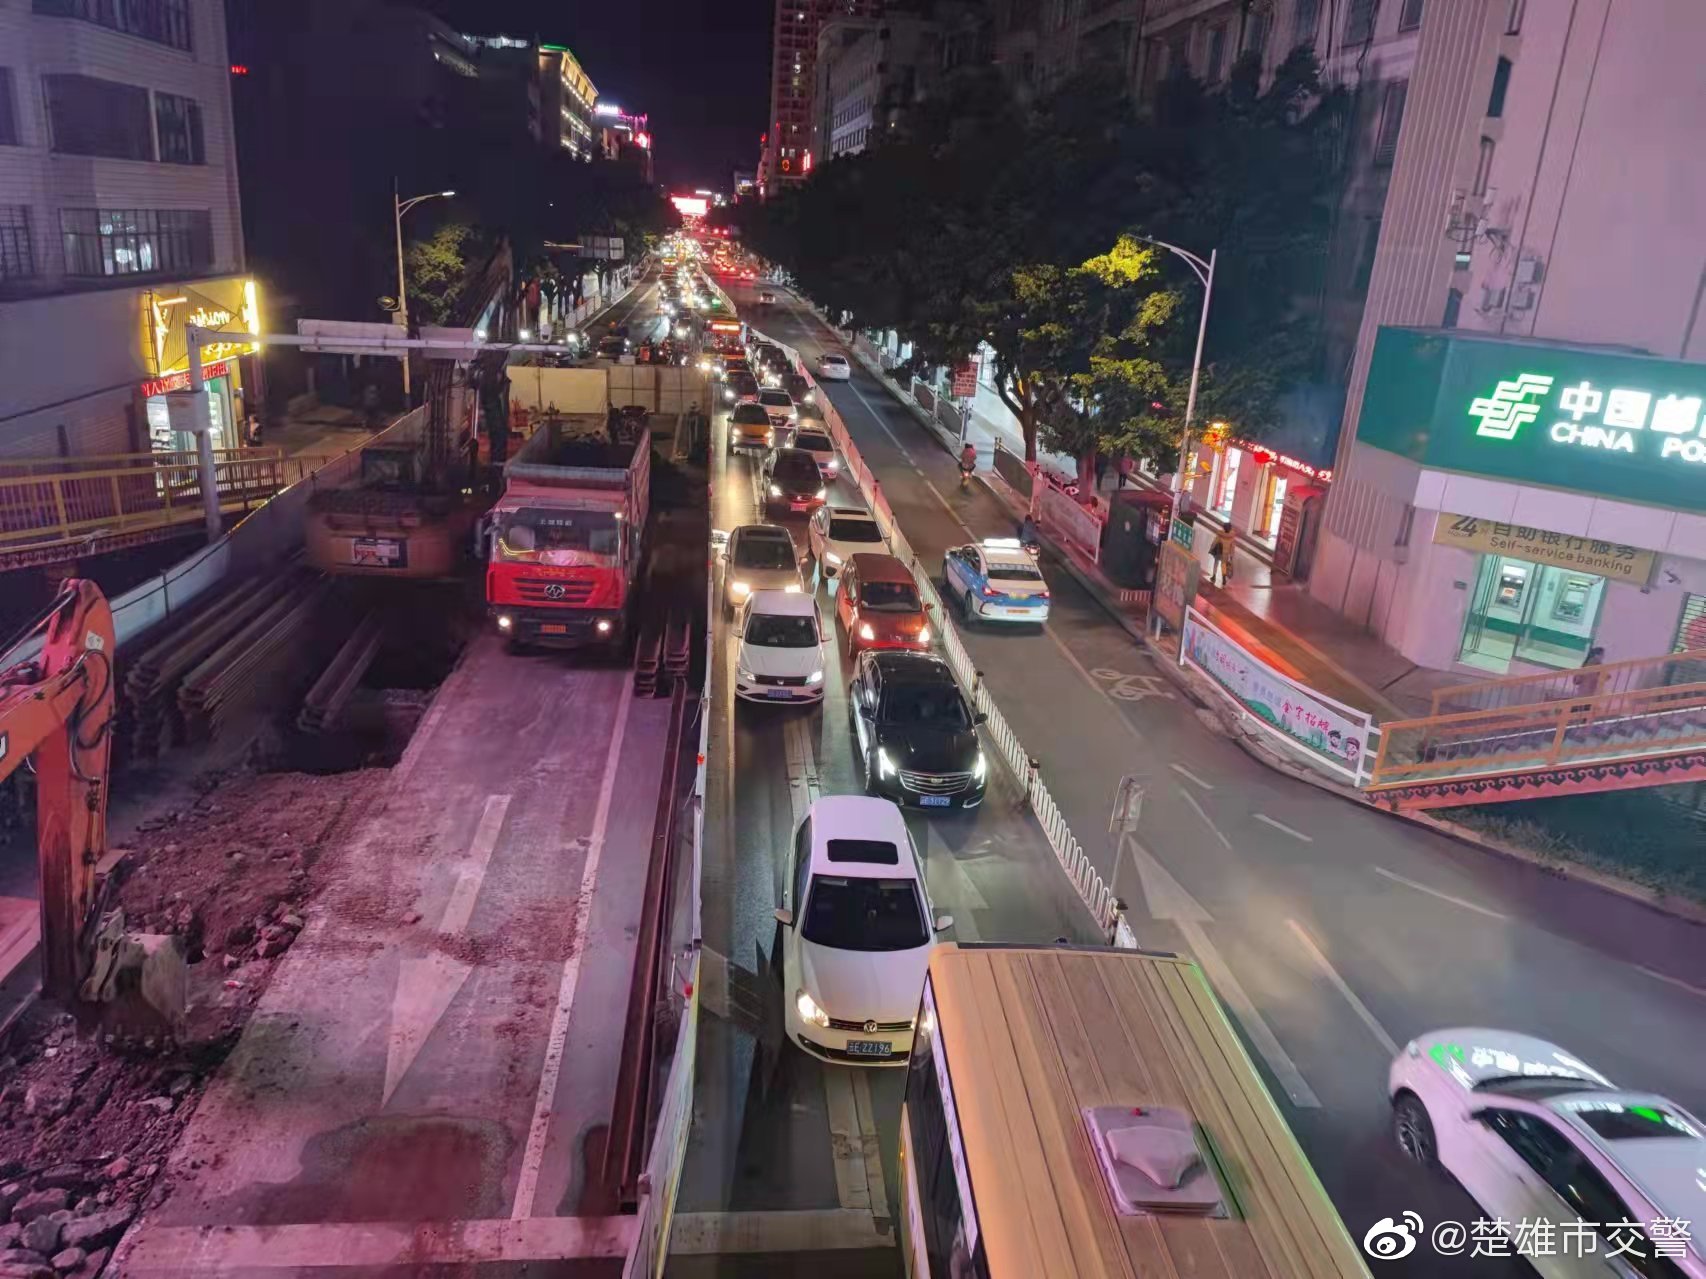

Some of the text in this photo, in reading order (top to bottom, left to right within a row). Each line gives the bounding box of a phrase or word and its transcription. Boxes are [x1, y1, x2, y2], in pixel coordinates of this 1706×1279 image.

[1559, 381, 1706, 438] 中国邮
[1551, 422, 1706, 464] CHINA PO
[1489, 536, 1633, 575] Self-service banking
